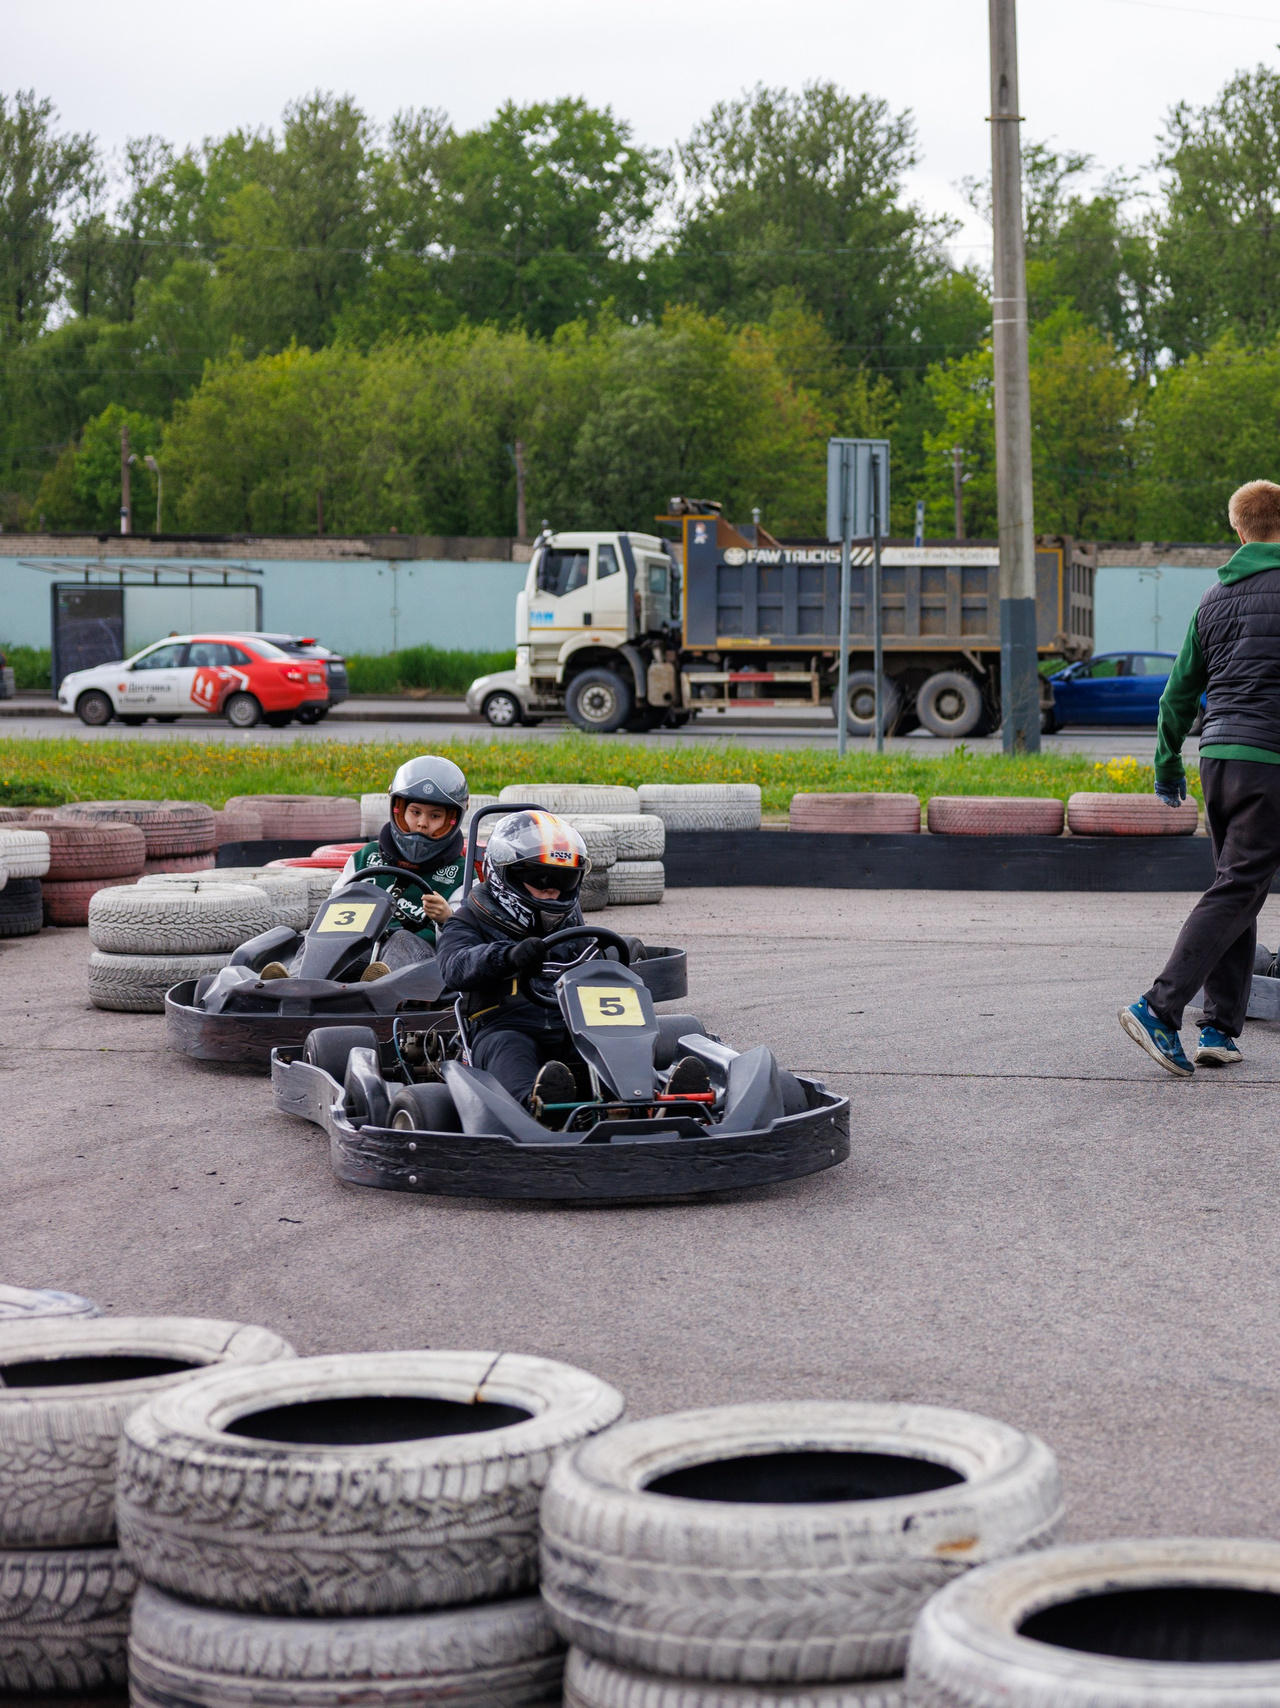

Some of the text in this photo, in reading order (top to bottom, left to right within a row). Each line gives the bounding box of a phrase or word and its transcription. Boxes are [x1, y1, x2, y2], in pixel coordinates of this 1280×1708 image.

[747, 549, 842, 564] FAW TRUCKS
[333, 910, 357, 926] 3
[599, 996, 626, 1016] 5
